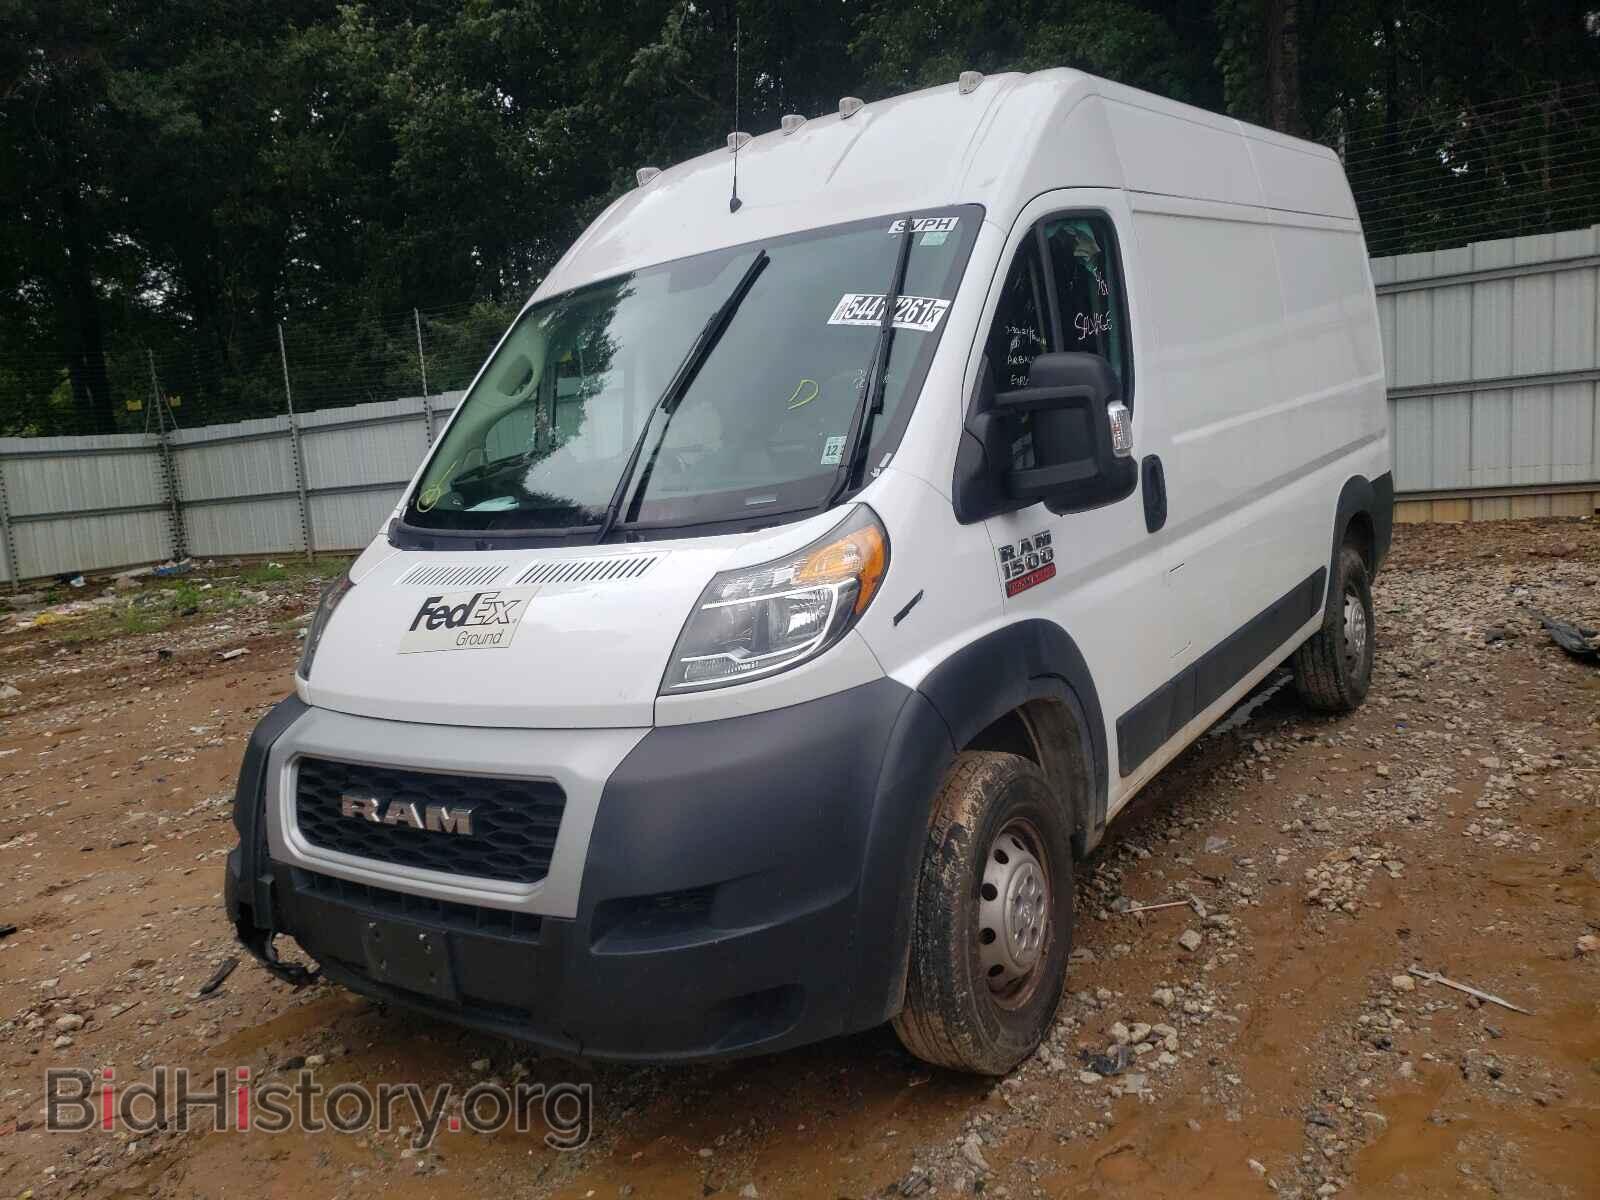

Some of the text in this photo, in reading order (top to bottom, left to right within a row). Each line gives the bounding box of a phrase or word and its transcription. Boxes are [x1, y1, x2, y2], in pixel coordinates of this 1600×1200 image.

[894, 218, 953, 232] SVPH
[826, 445, 839, 457] 12
[999, 529, 1052, 563] RAM
[1002, 546, 1054, 580] 1500
[408, 591, 522, 631] FedEx
[455, 629, 505, 646] Ground
[341, 794, 473, 836] RAM
